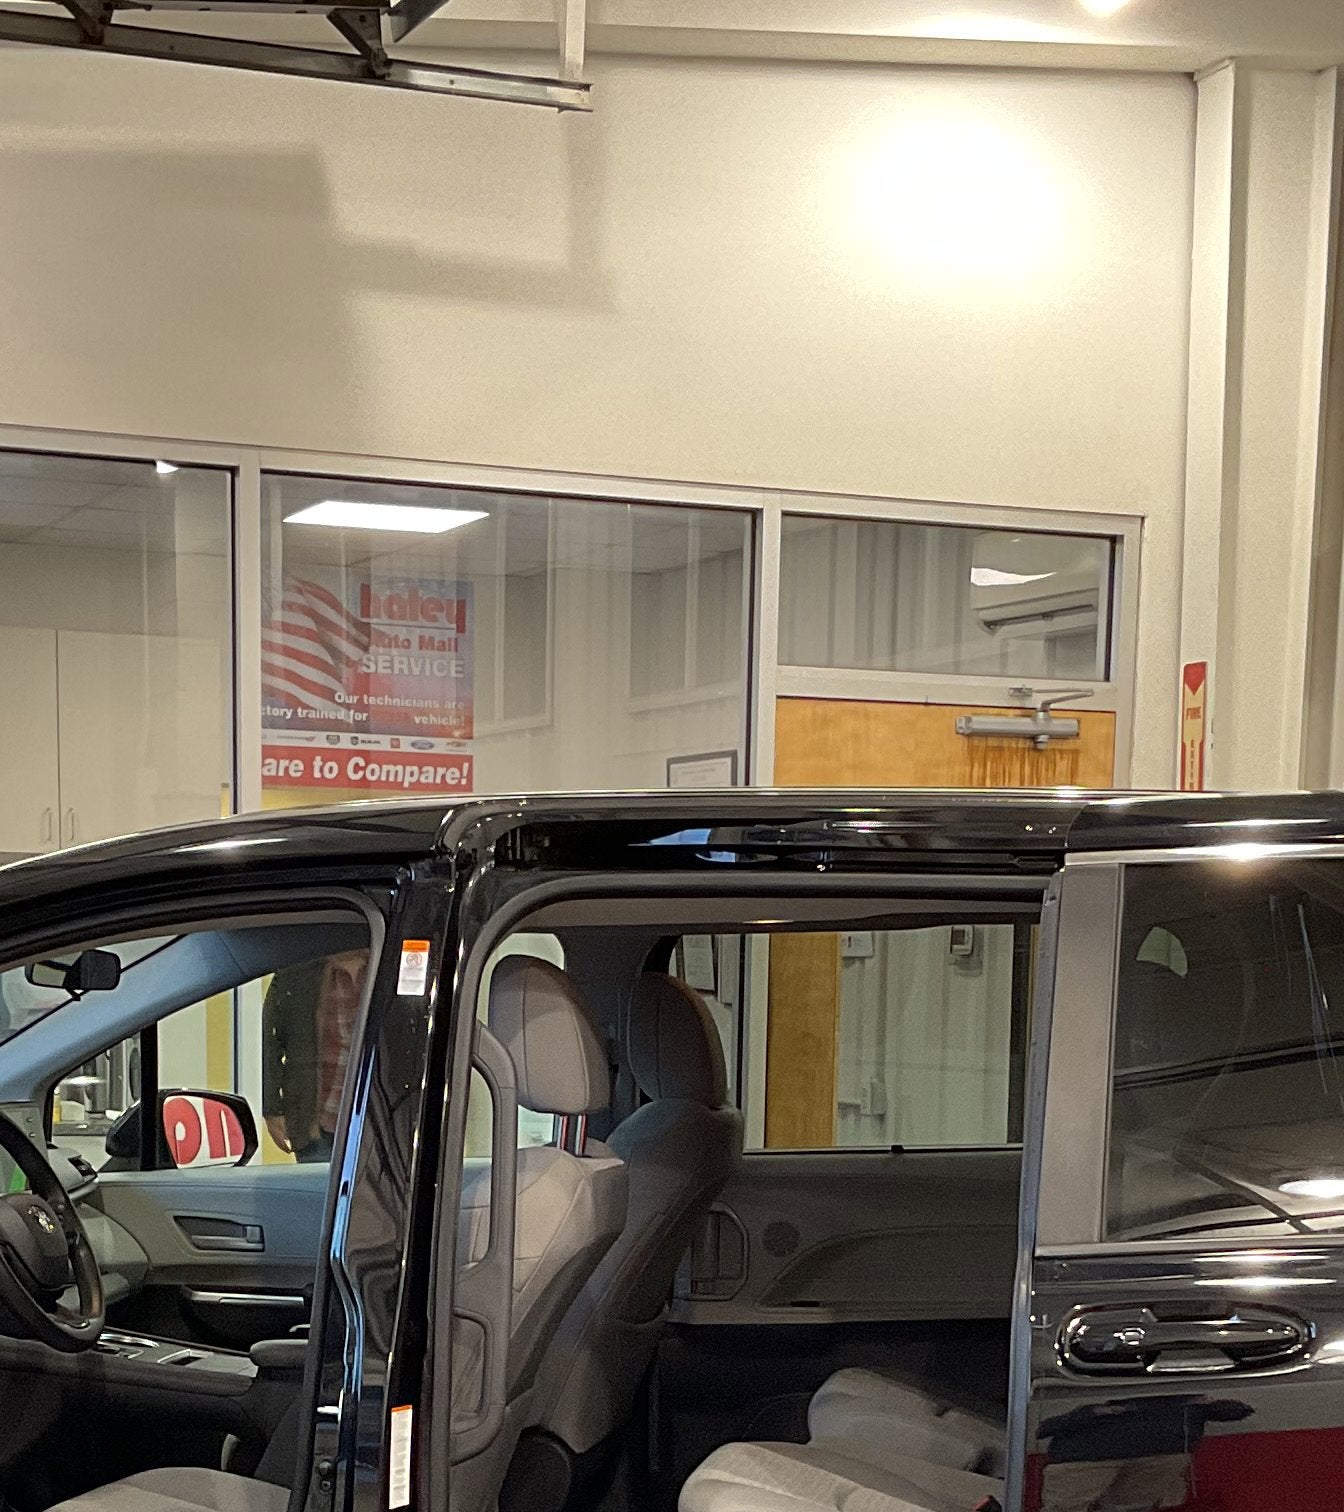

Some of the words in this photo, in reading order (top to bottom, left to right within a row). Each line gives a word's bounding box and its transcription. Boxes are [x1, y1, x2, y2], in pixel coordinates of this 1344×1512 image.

[419, 635, 458, 652] Mall
[362, 655, 465, 678] SERVICE
[334, 692, 359, 705] Our
[363, 694, 440, 709] technicians
[262, 706, 293, 719] tory
[297, 707, 344, 720] trained
[349, 708, 368, 724] for
[414, 714, 465, 726] vehicle!
[312, 756, 339, 779] to
[346, 756, 469, 787] Compare!
